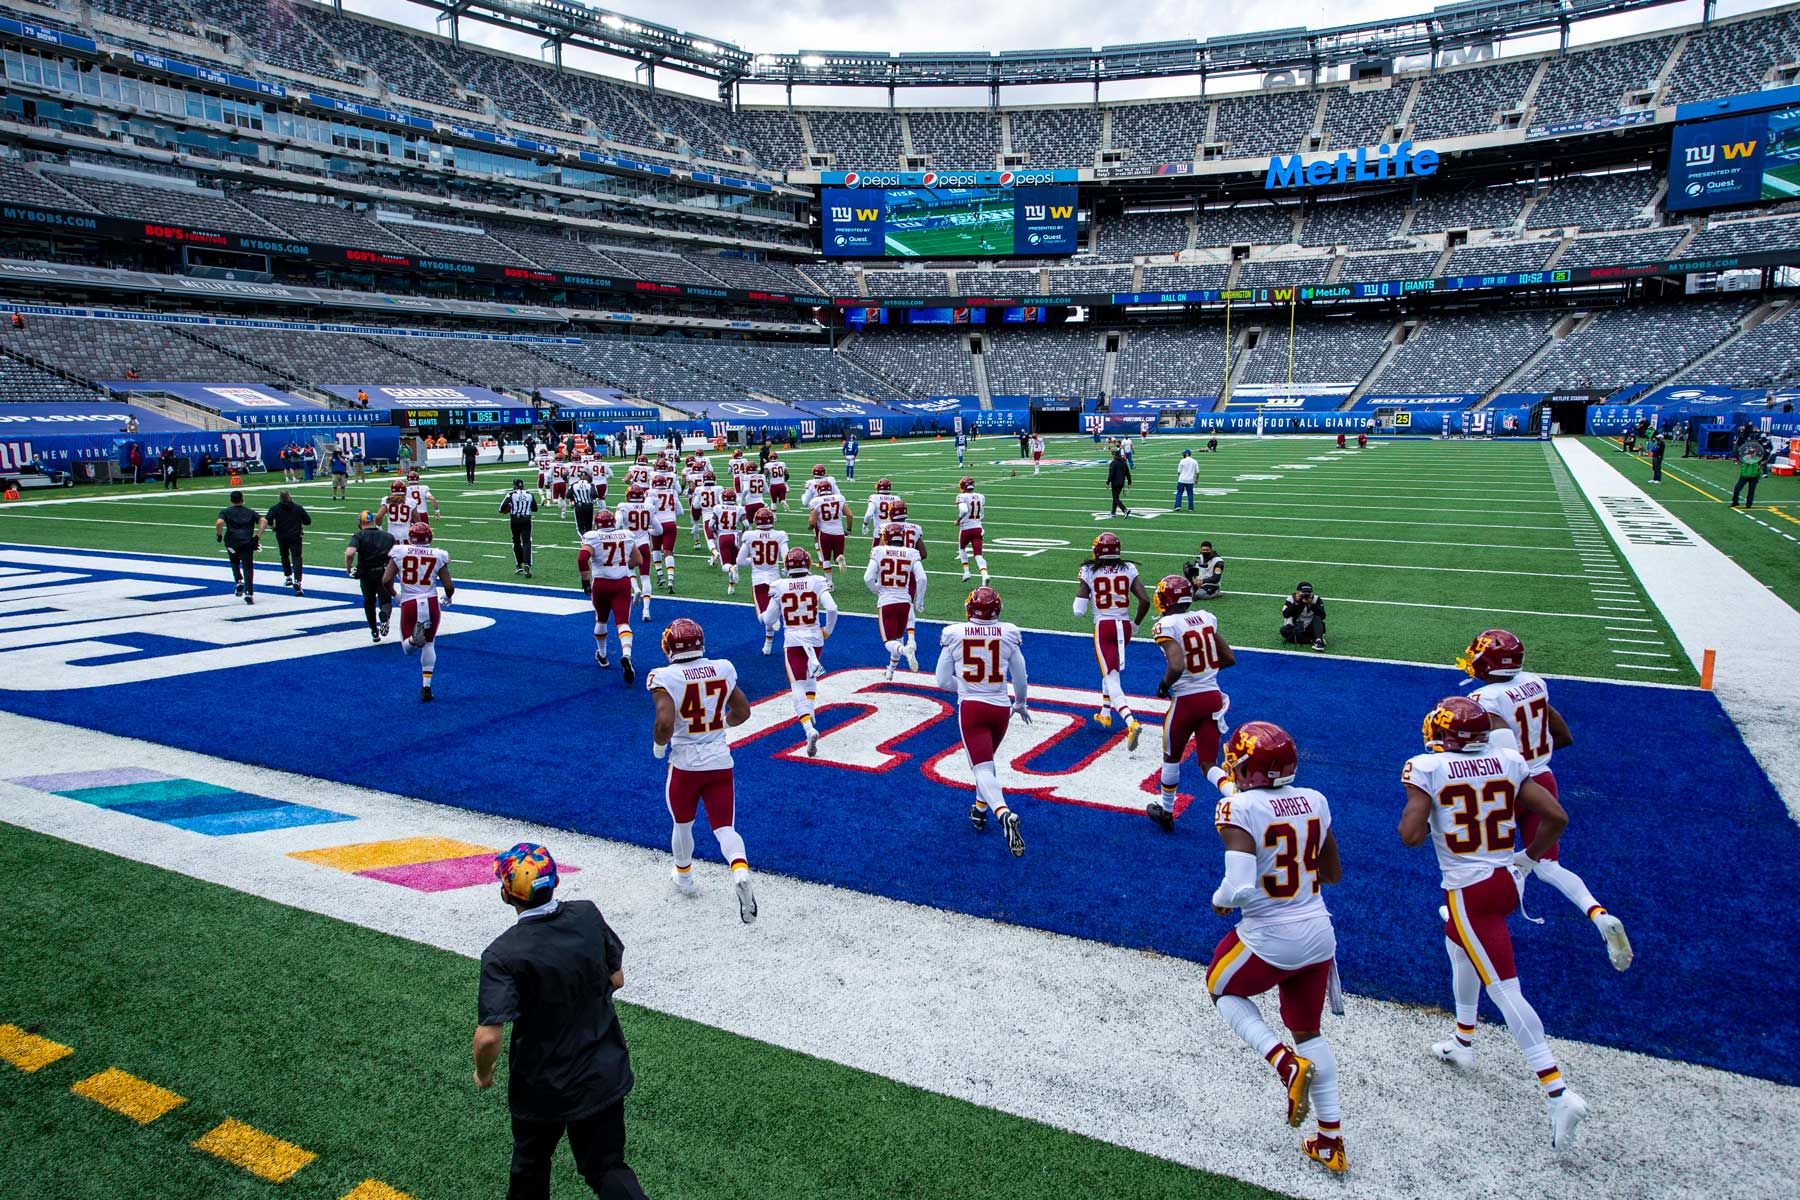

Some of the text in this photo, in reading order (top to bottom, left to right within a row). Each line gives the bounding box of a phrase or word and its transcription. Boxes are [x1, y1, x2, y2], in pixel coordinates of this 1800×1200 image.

[1685, 144, 1716, 167] ny
[1720, 141, 1757, 160] W
[1177, 164, 1187, 173] ny
[1265, 141, 1439, 189] MetLife
[940, 174, 977, 187] pepsi
[1016, 172, 1054, 186] pepsi
[1688, 170, 1729, 179] PRESENTED
[863, 176, 900, 188] pepsi
[1707, 180, 1735, 189] Quest
[4, 208, 97, 229] MYBOBS.COM
[831, 207, 852, 222] ny
[856, 209, 878, 221] W
[1025, 205, 1046, 221] ny
[1049, 206, 1073, 219] W
[145, 225, 184, 240] BOB'S
[240, 239, 309, 255] MYBOBS.COM
[346, 250, 377, 262] BOB'S
[1, 264, 58, 275] MetLife
[419, 260, 475, 273] MYBOBS.COM
[1669, 259, 1738, 271] MYBOBS.COM
[505, 268, 529, 279] BOB'S
[1519, 273, 1543, 284] 10:52
[1556, 271, 1566, 280] 25
[179, 280, 292, 297] METLIFE STADIUM
[564, 276, 611, 287] MYBOBS.COM
[1405, 280, 1434, 291] GIANTS
[1274, 289, 1292, 300] W
[1316, 287, 1350, 297] MetLife
[1364, 284, 1378, 296] ny
[1382, 283, 1389, 295] 0
[381, 388, 465, 397] GIANTS
[237, 415, 257, 423] NEW
[265, 415, 289, 423] YORK
[296, 414, 341, 422] FOOTBALL
[476, 412, 492, 421] 10:52
[1201, 418, 1367, 427] NEW YORK FOOTALL GIANTS
[1397, 415, 1408, 423] 25
[801, 420, 815, 438] ny
[869, 419, 882, 435] ny
[181, 443, 219, 453] GIANTS
[222, 432, 261, 461] ny
[42, 448, 109, 460] NEW YORK
[593, 466, 605, 477] 94
[633, 470, 648, 482] 73
[733, 464, 746, 475] 24
[772, 466, 784, 478] 60
[750, 479, 764, 494] 52
[411, 491, 421, 505] 9
[657, 494, 675, 511] 74
[701, 491, 716, 508] 31
[388, 504, 410, 523] 99
[821, 501, 840, 521] 67
[879, 502, 889, 520] 9
[969, 501, 981, 519] 11
[628, 511, 650, 531] 90
[719, 511, 737, 530] 41
[407, 548, 434, 556] SPRINKLE
[603, 541, 626, 567] 71
[751, 540, 779, 566] 30
[402, 555, 438, 586] 87
[880, 558, 911, 587] 25
[789, 582, 808, 591] DARBY
[1093, 575, 1130, 609] 89
[782, 591, 818, 626] 23
[1184, 616, 1205, 626] INMAN
[965, 627, 1002, 637] HAMILTON
[1183, 626, 1220, 674] 80
[1475, 638, 1492, 652] 17
[962, 639, 1004, 684] 51
[683, 666, 717, 680] HUDSON
[1505, 680, 1543, 703] McLAURIN
[680, 679, 728, 734] 47
[1433, 707, 1455, 729] 32
[1515, 697, 1549, 761] 17
[1448, 757, 1503, 779] JOHNSON
[1269, 796, 1312, 817] BARBER
[1439, 778, 1515, 855] 32
[1262, 818, 1320, 898] 34
